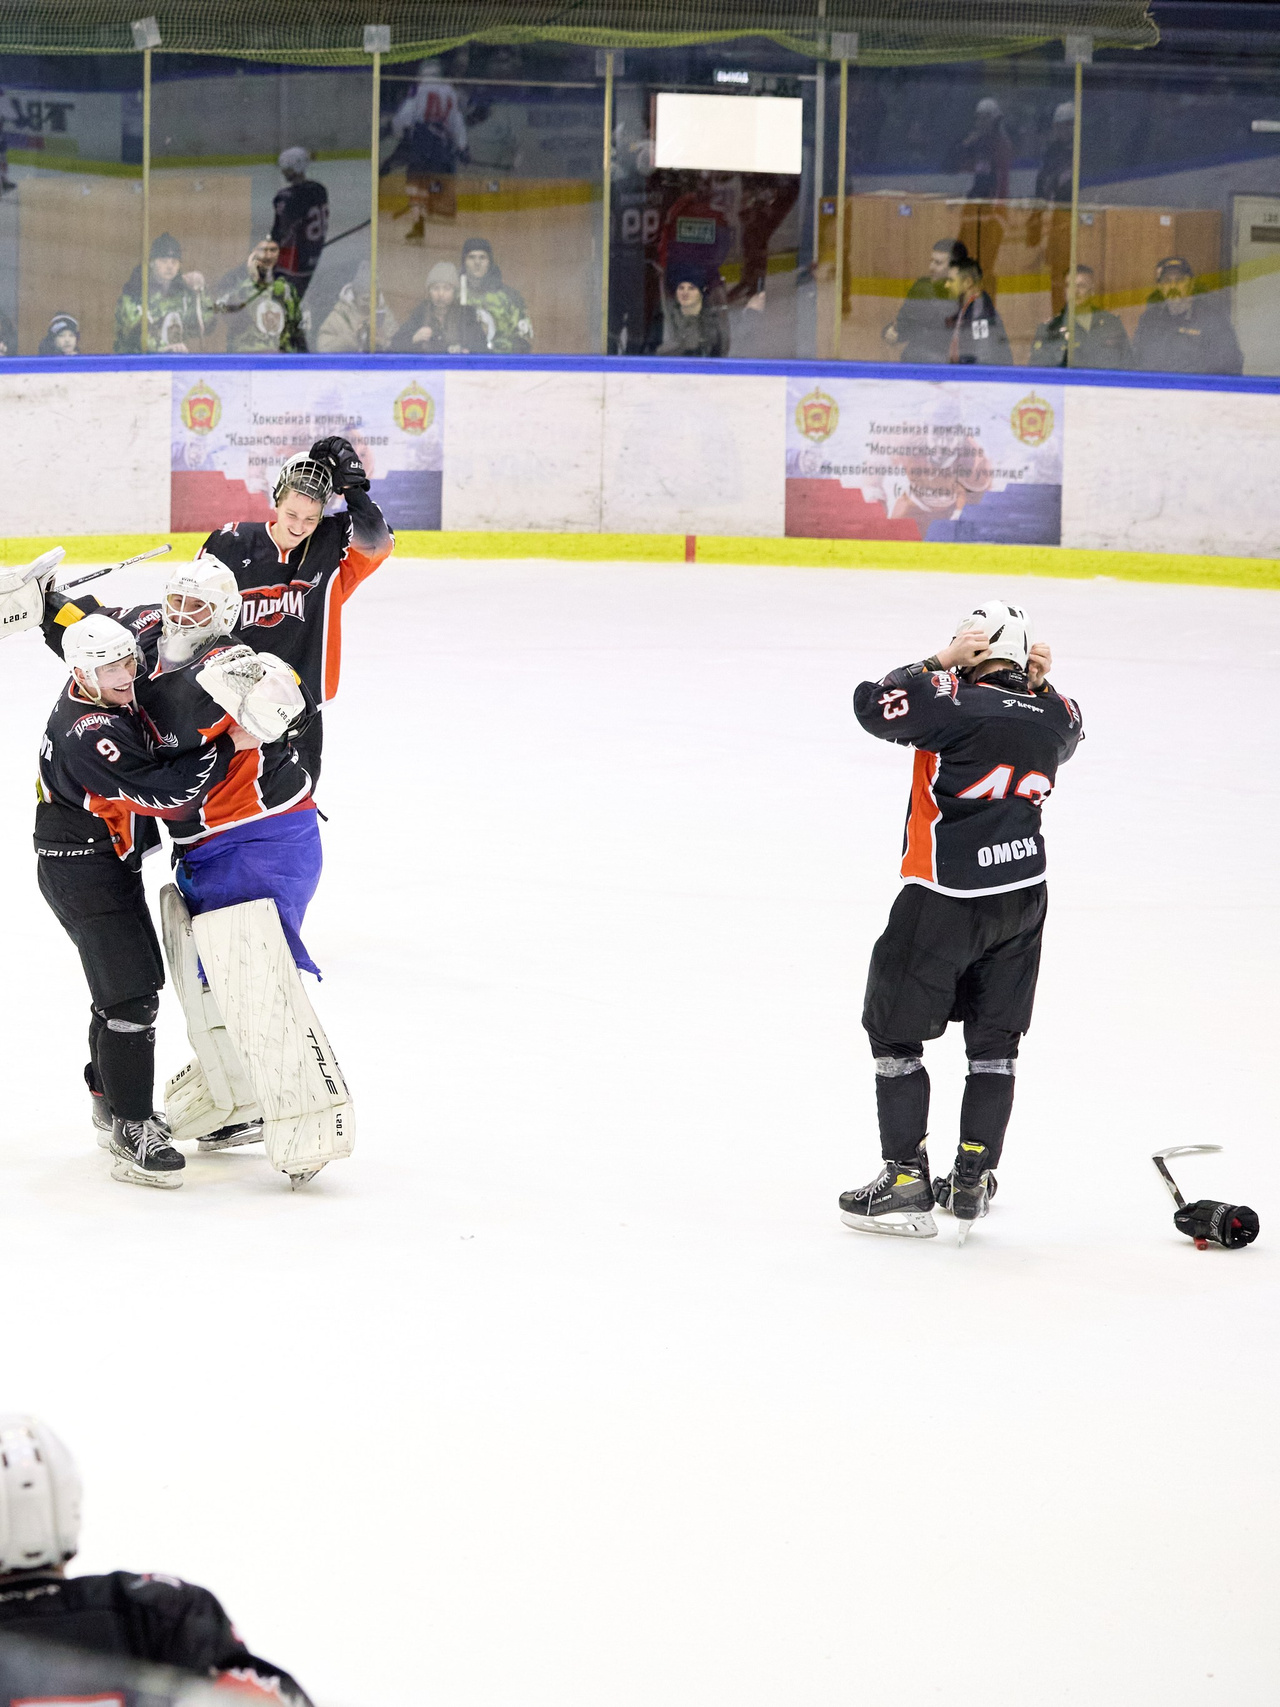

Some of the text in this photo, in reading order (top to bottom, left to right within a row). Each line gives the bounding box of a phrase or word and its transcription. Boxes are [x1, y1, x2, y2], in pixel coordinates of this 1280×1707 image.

[251, 412, 363, 427] Хоккейная команда
[870, 421, 981, 437] Хоккейная команда
[225, 433, 288, 447] "Казанское
[865, 442, 937, 457] "Московское
[820, 461, 907, 477] общевойсковое
[3, 611, 28, 625] L20.2
[878, 688, 910, 721] 43
[1017, 700, 1045, 714] keeper
[95, 737, 122, 763] 9
[977, 836, 1039, 868] ОМСК
[306, 1027, 339, 1096] TRUE
[170, 1064, 192, 1086] L20.2
[335, 1113, 343, 1137] L20.2
